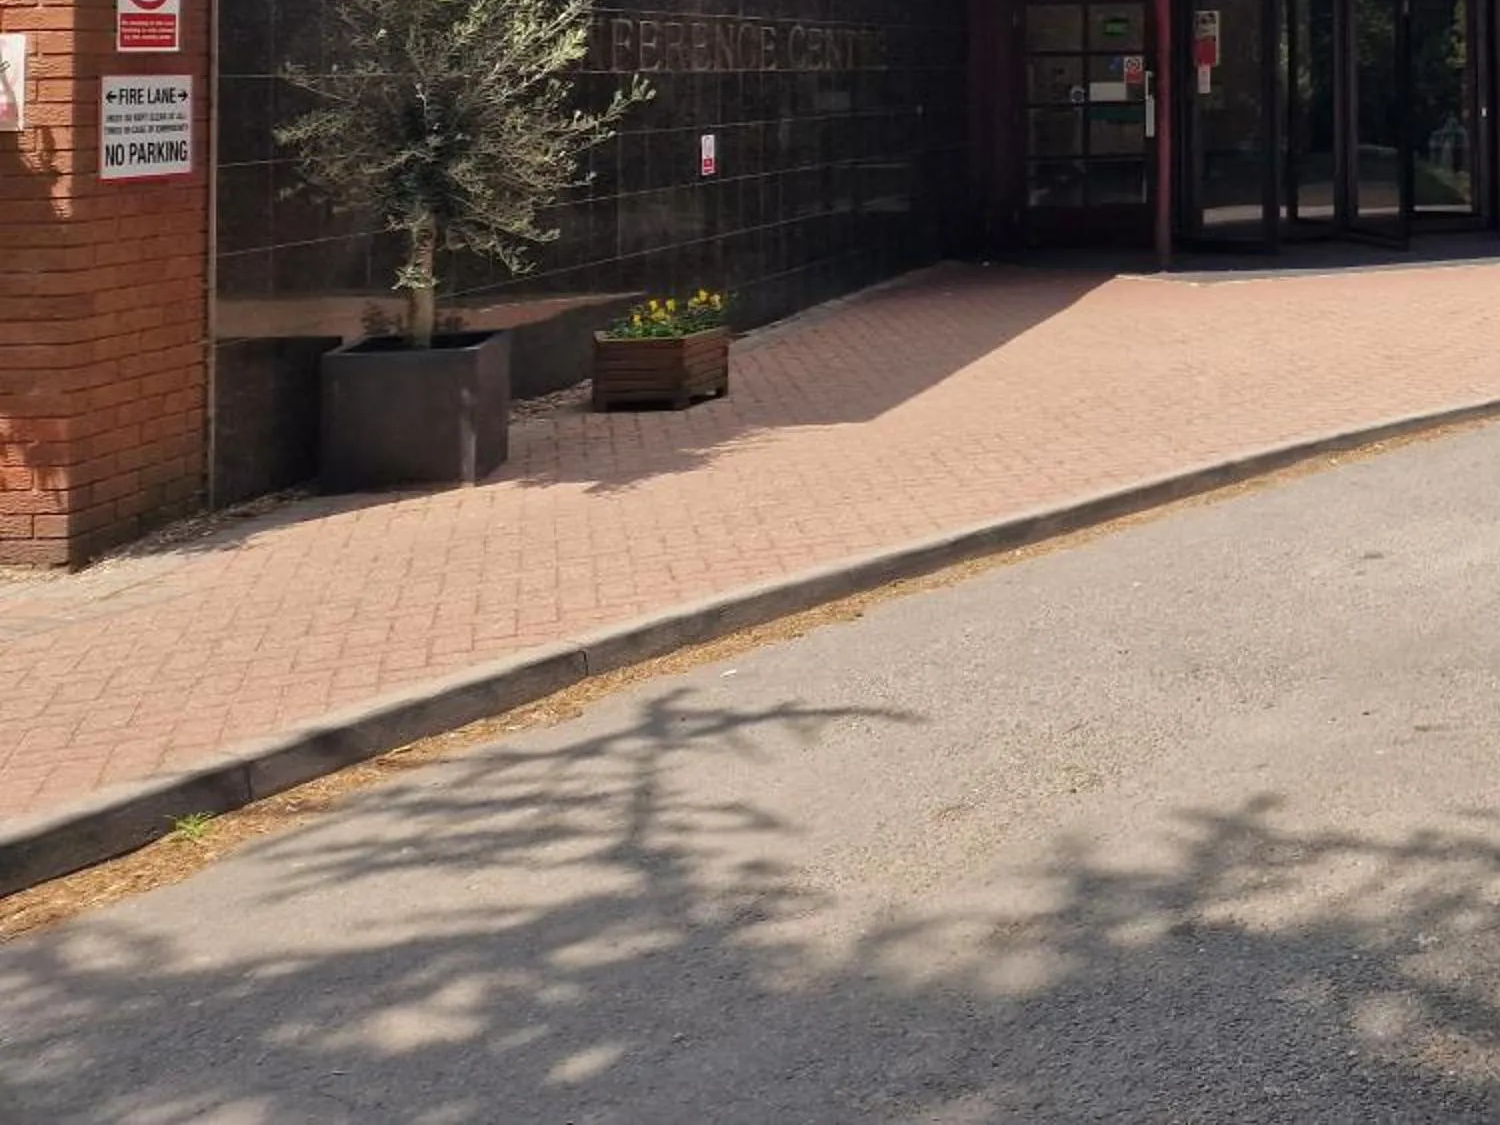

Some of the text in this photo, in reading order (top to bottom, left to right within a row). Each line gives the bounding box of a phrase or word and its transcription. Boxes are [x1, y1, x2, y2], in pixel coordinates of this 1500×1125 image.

[118, 85, 177, 106] FIRE LANE
[105, 139, 188, 168] NO PARKING
